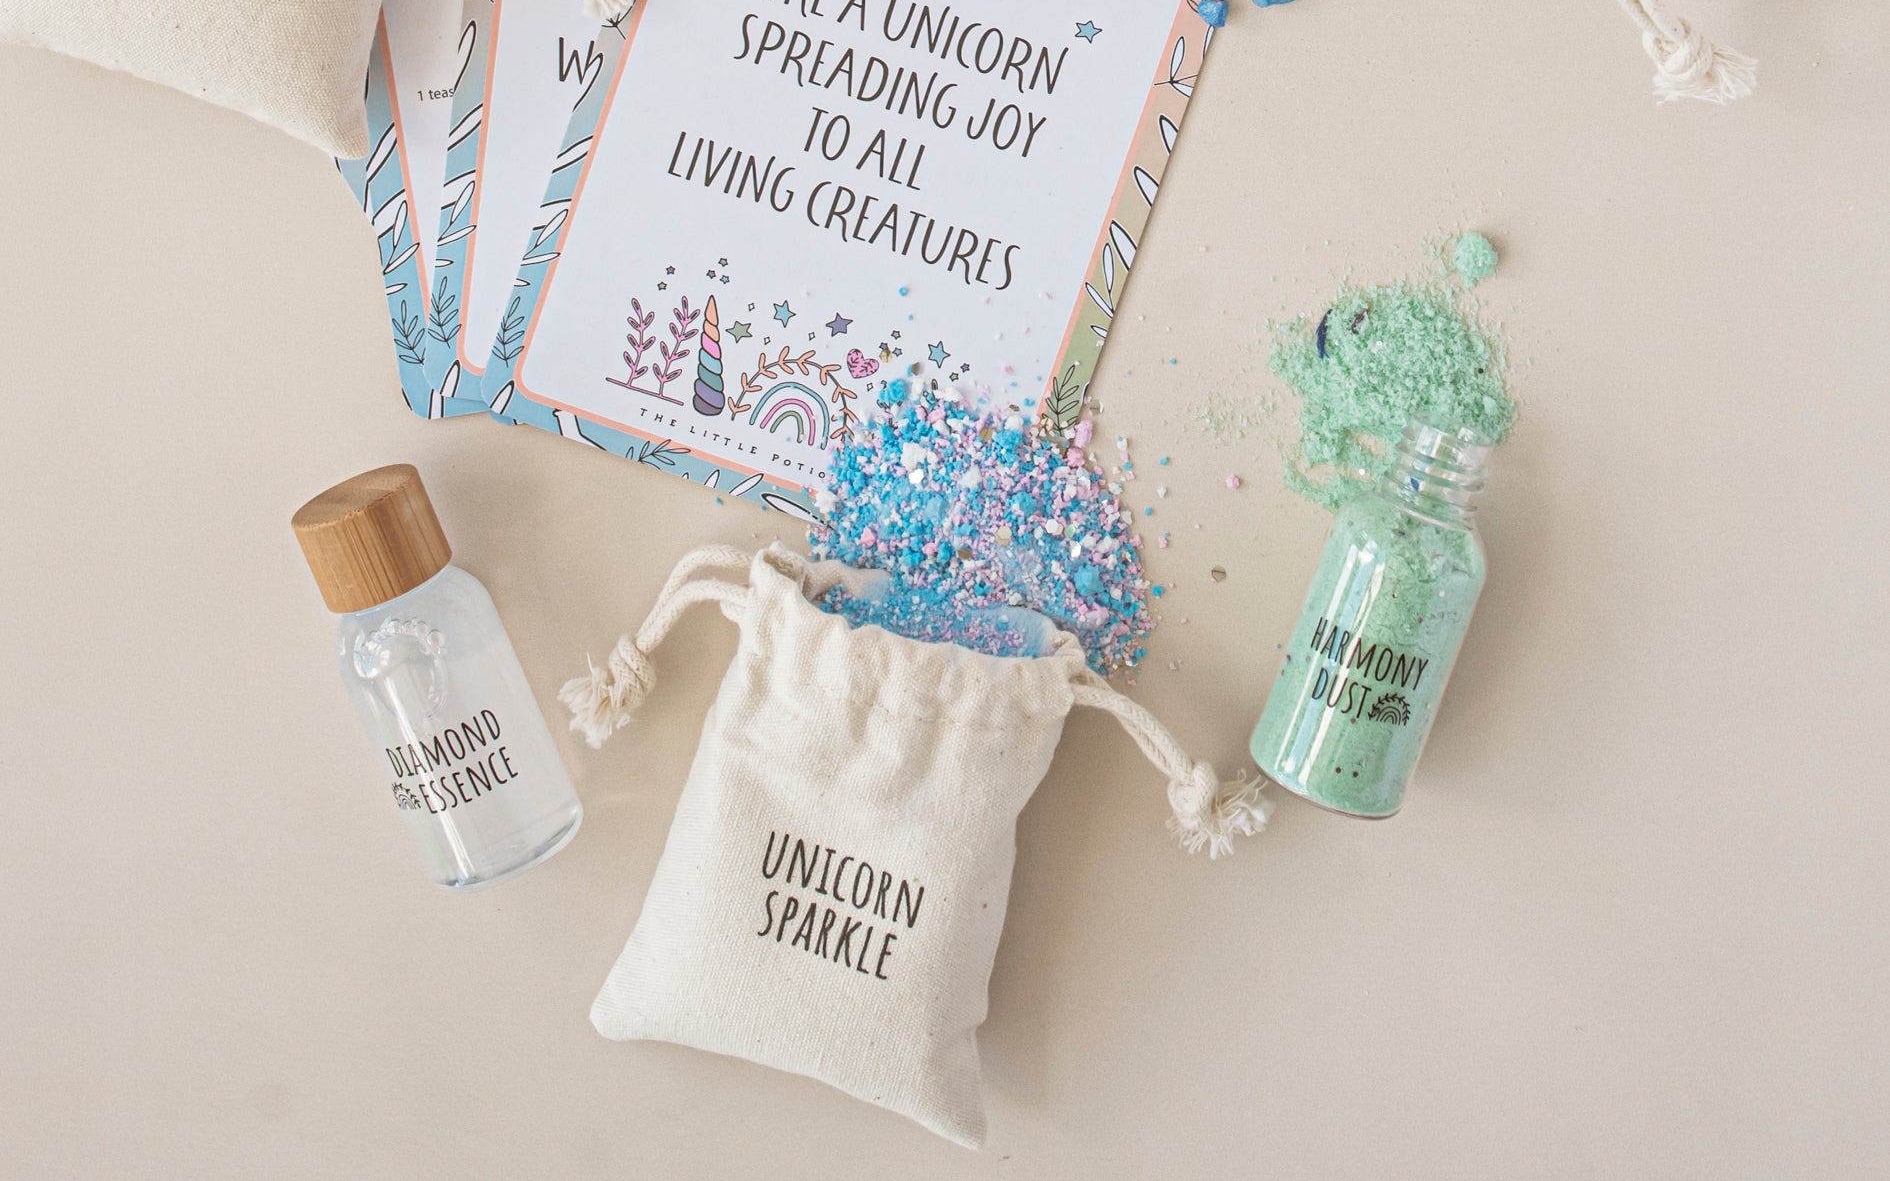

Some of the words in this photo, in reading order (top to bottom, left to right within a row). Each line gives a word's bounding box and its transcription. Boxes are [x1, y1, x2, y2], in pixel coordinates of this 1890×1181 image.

[417, 90, 424, 101] 1
[733, 13, 958, 130] SPREADING
[966, 98, 1047, 158] JOY
[803, 106, 851, 161] TO
[855, 129, 926, 191] ALL
[667, 131, 796, 213] LIVING
[807, 180, 1021, 291] CREATURES
[640, 407, 677, 427] THE
[690, 425, 758, 455] LITTLE
[771, 453, 834, 479] POTIO
[1310, 616, 1430, 691] HARMONY
[1312, 667, 1373, 719] DUST
[385, 709, 501, 778] DIAMOND
[418, 746, 519, 815] ESSENCE
[762, 831, 925, 928] UNICORN
[757, 890, 898, 980] SPARKLE
